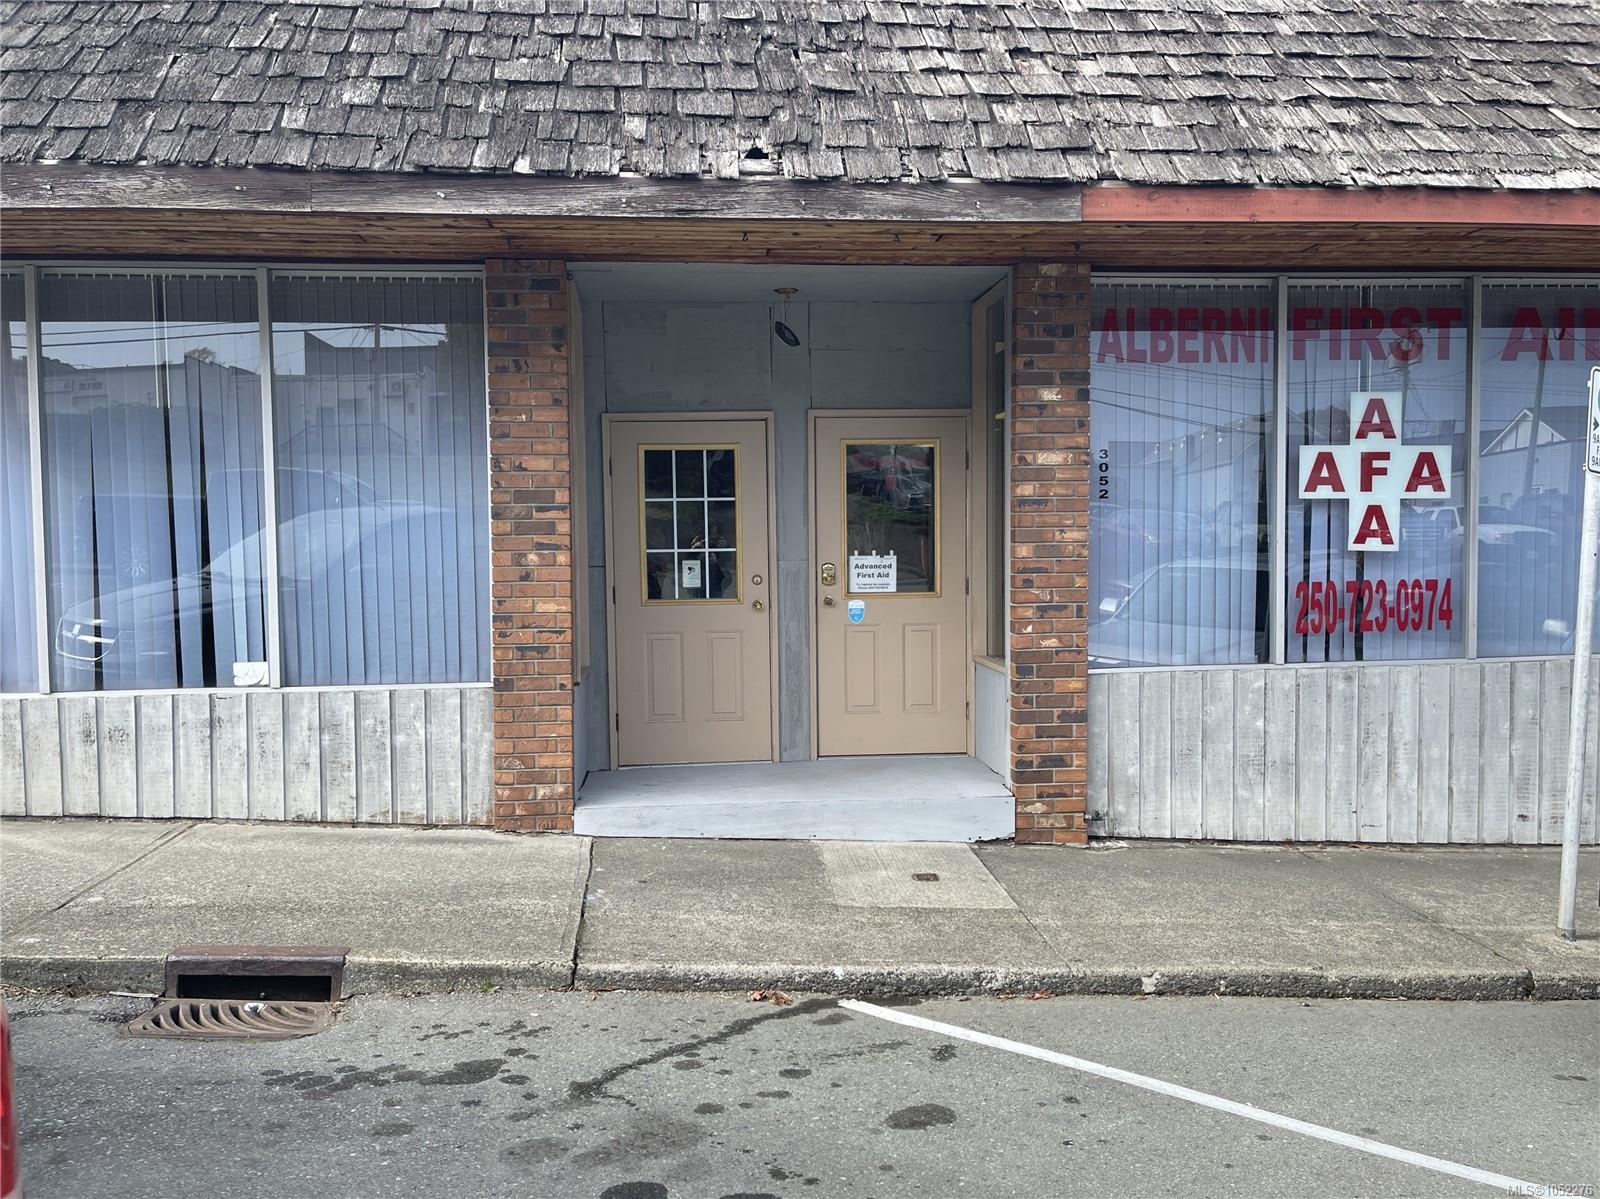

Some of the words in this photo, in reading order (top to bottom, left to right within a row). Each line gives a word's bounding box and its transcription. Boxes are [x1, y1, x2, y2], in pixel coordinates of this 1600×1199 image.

[1096, 307, 1270, 364] ALBERNI
[1292, 307, 1463, 361] FIRST
[1098, 448, 1110, 500] 3052
[1295, 577, 1453, 635] 250-723-0974
